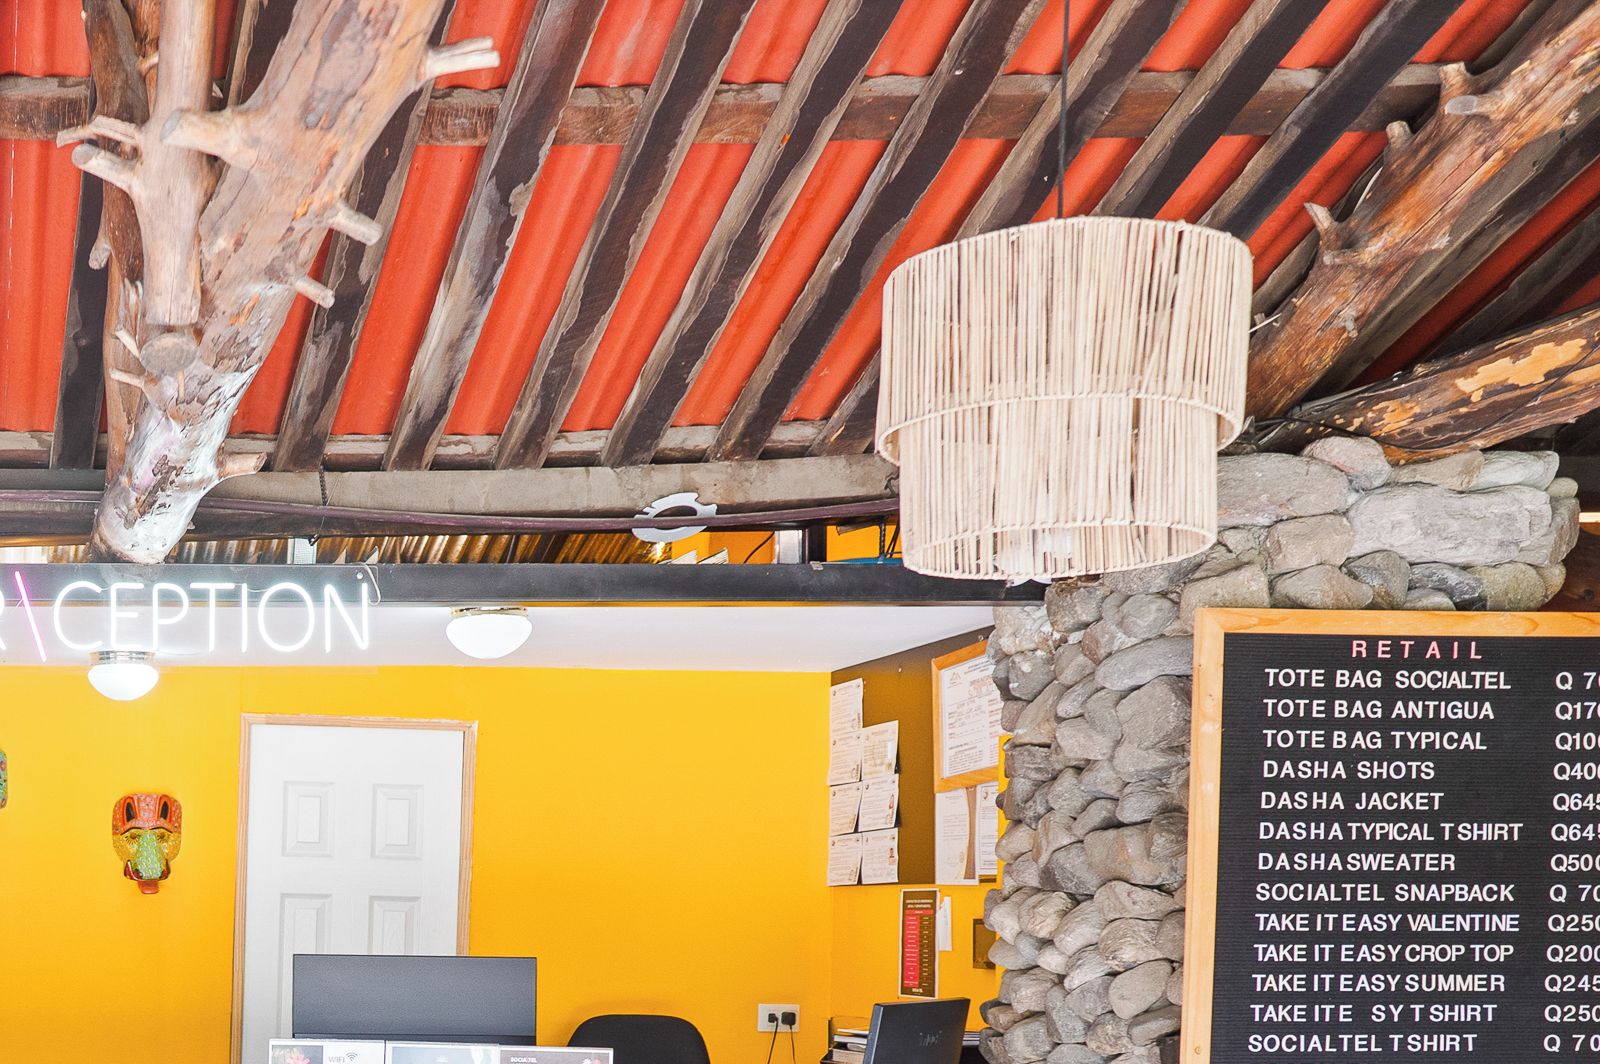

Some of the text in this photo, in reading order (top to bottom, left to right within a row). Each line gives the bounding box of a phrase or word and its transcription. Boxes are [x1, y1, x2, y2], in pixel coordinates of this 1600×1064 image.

[1351, 640, 1482, 660] RETAIL
[1264, 668, 1325, 688] TOTE
[1335, 669, 1382, 689] BAG
[1395, 670, 1512, 691] SOCIALTEL
[1583, 671, 1600, 690] 7
[1262, 698, 1600, 721] TOTE BAG ANTIGUA Q17
[1262, 729, 1600, 752] TOTE BAG TYPICAL Q10
[1263, 760, 1600, 781] DASHA SHOTS Q40
[1260, 791, 1345, 810] DASHA
[1355, 791, 1445, 811] JACKET
[1259, 821, 1344, 841] DASHA
[1347, 822, 1435, 841] TYPICAL
[1550, 823, 1600, 842] Q64
[1258, 852, 1343, 871] DASHA
[1346, 852, 1456, 871] SWEATER
[1255, 882, 1385, 902] SOCIALTEL
[1394, 883, 1515, 902] SNAPBACK
[1254, 913, 1310, 932] TAKE
[1316, 913, 1339, 932] IT
[1342, 913, 1403, 932] EASY
[1406, 913, 1520, 932] VALENTINE
[1253, 943, 1308, 962] TAKE
[1314, 944, 1335, 962] IT
[1340, 944, 1403, 963] EASY
[1404, 944, 1466, 963] CROP
[1469, 944, 1514, 962] TOP
[1251, 973, 1307, 992] TAKE
[1313, 974, 1335, 992] IT
[1339, 973, 1401, 993] EASY
[1404, 973, 1505, 993] SUMMER
[1249, 1004, 1308, 1022] TAKE
[1247, 1034, 1383, 1053] SOCIALTEL
[1572, 1034, 1600, 1052] 70
